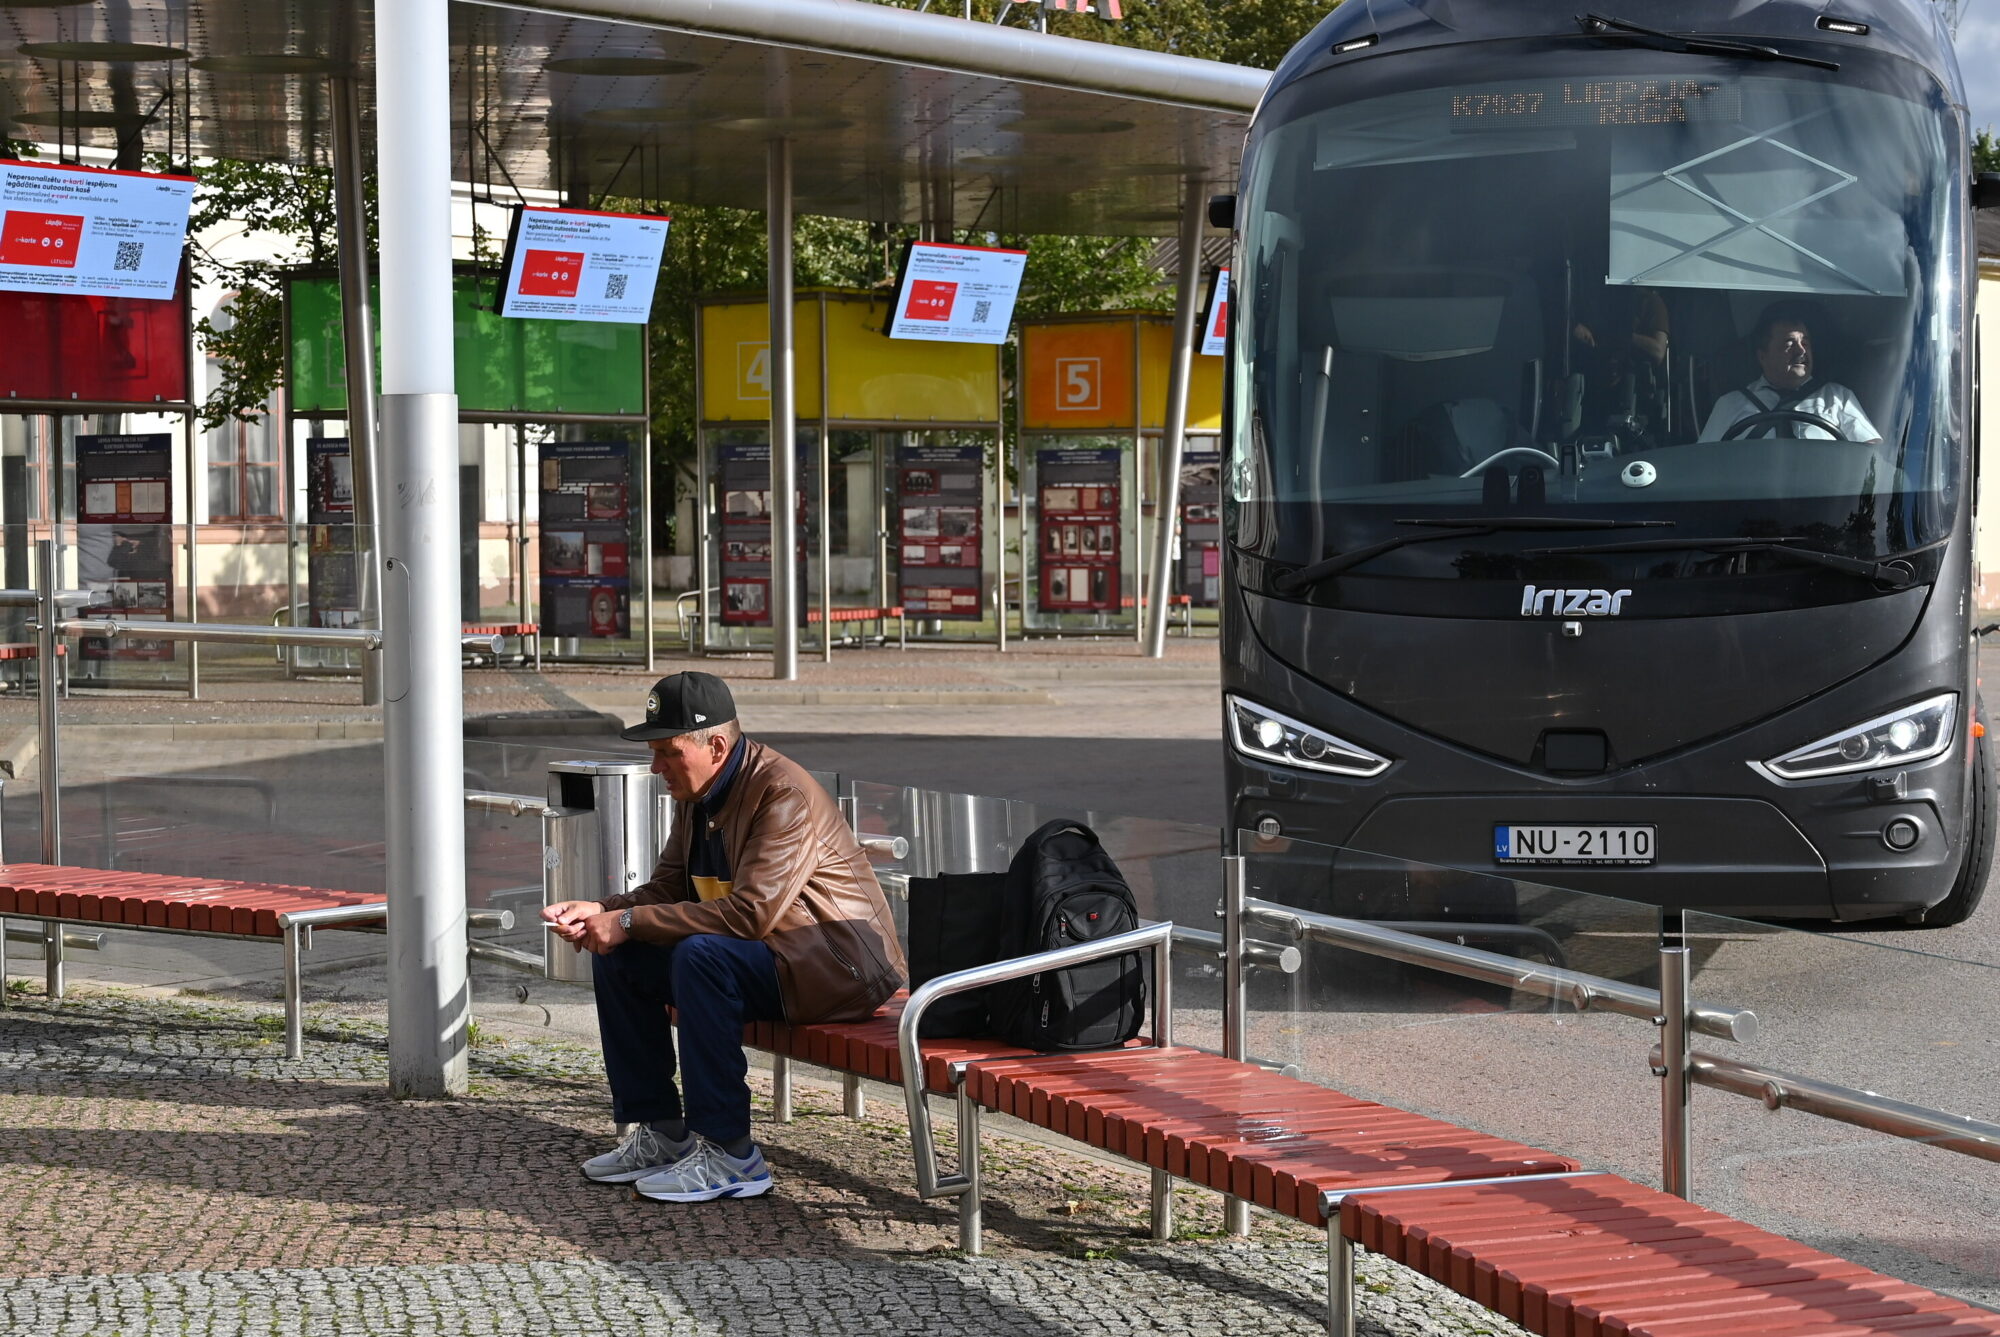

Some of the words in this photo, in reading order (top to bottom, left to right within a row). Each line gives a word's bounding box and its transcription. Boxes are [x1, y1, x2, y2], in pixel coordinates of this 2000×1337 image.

[42, 183, 74, 192] autoostas
[75, 185, 90, 193] kasē
[62, 177, 84, 185] e-karti
[86, 179, 117, 188] iespējams
[746, 349, 771, 391] 4
[1067, 364, 1090, 403] 5
[1521, 585, 1632, 616] Irizar
[1496, 845, 1508, 853] LV
[1516, 829, 1649, 856] NU-2110
